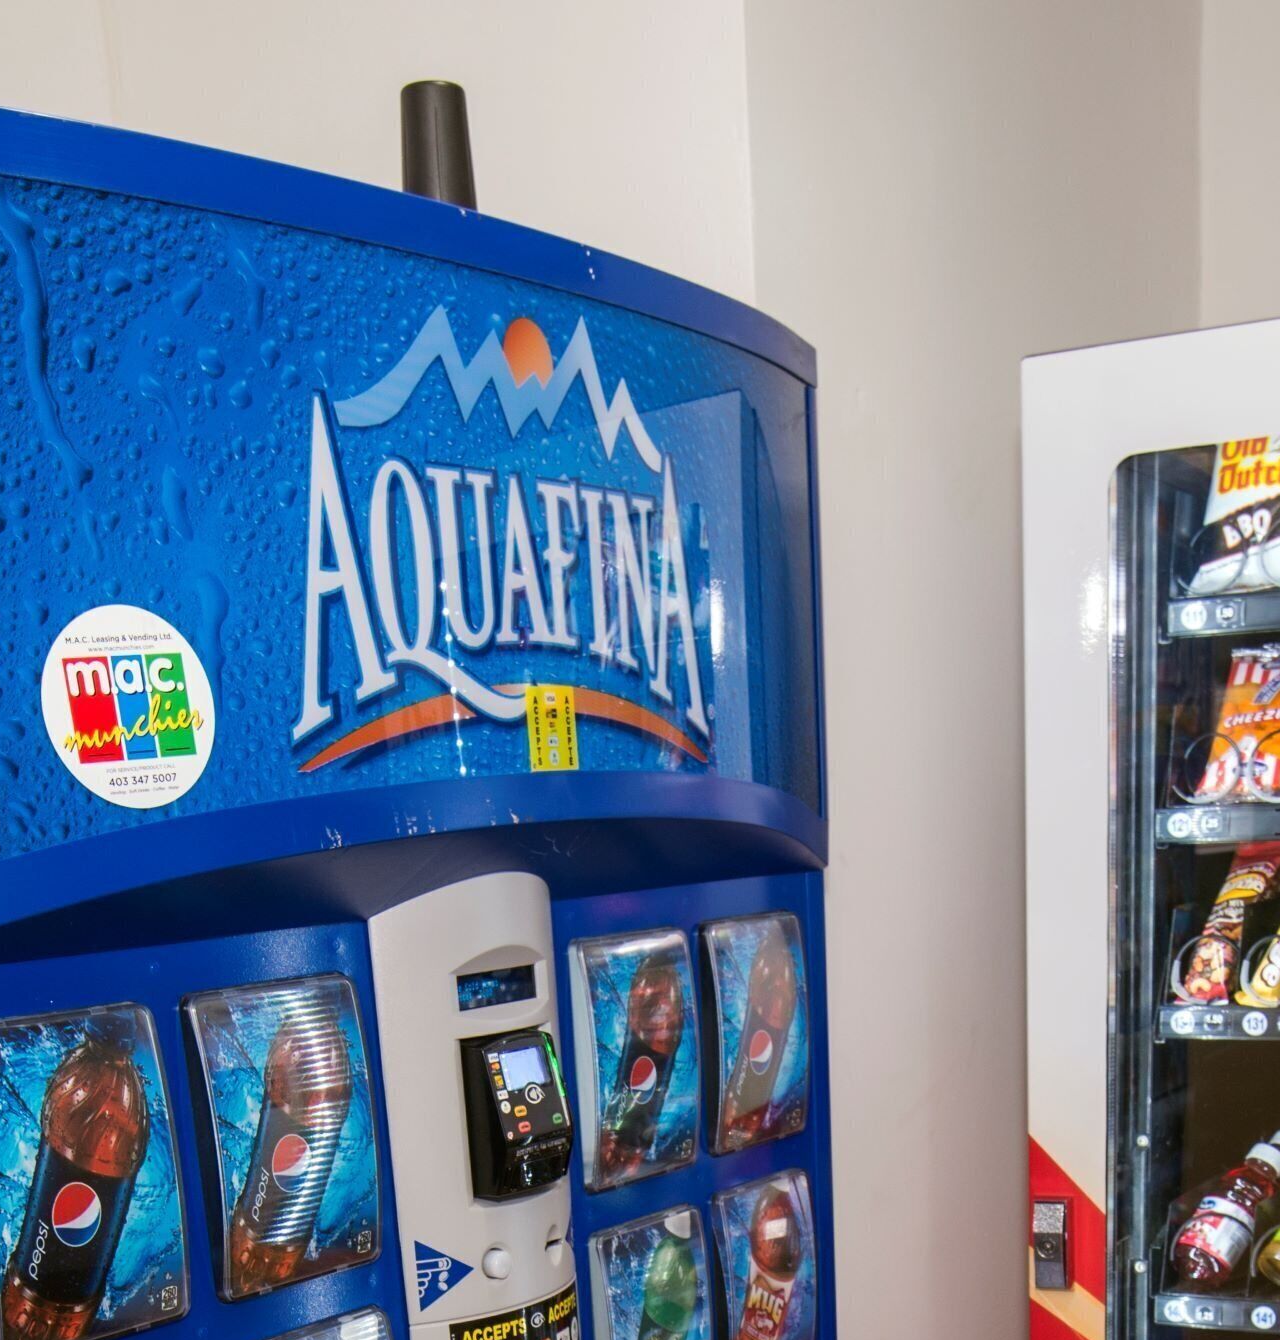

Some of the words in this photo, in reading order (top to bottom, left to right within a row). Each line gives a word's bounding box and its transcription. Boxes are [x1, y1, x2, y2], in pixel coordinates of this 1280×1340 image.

[1222, 507, 1272, 550] BBQ
[292, 393, 710, 743] AQUAFINA
[91, 635, 120, 644] Leasing
[121, 634, 127, 642] &
[128, 633, 158, 642] Vending
[64, 693, 204, 752] munchies
[109, 777, 129, 787] 403
[131, 775, 149, 785] 347
[152, 772, 177, 784] 5007
[1246, 1018, 1266, 1031] 131
[251, 1166, 270, 1222] pepsi
[28, 1218, 50, 1281] pepsi
[747, 1283, 785, 1325] MUG
[1254, 1311, 1273, 1325] 141
